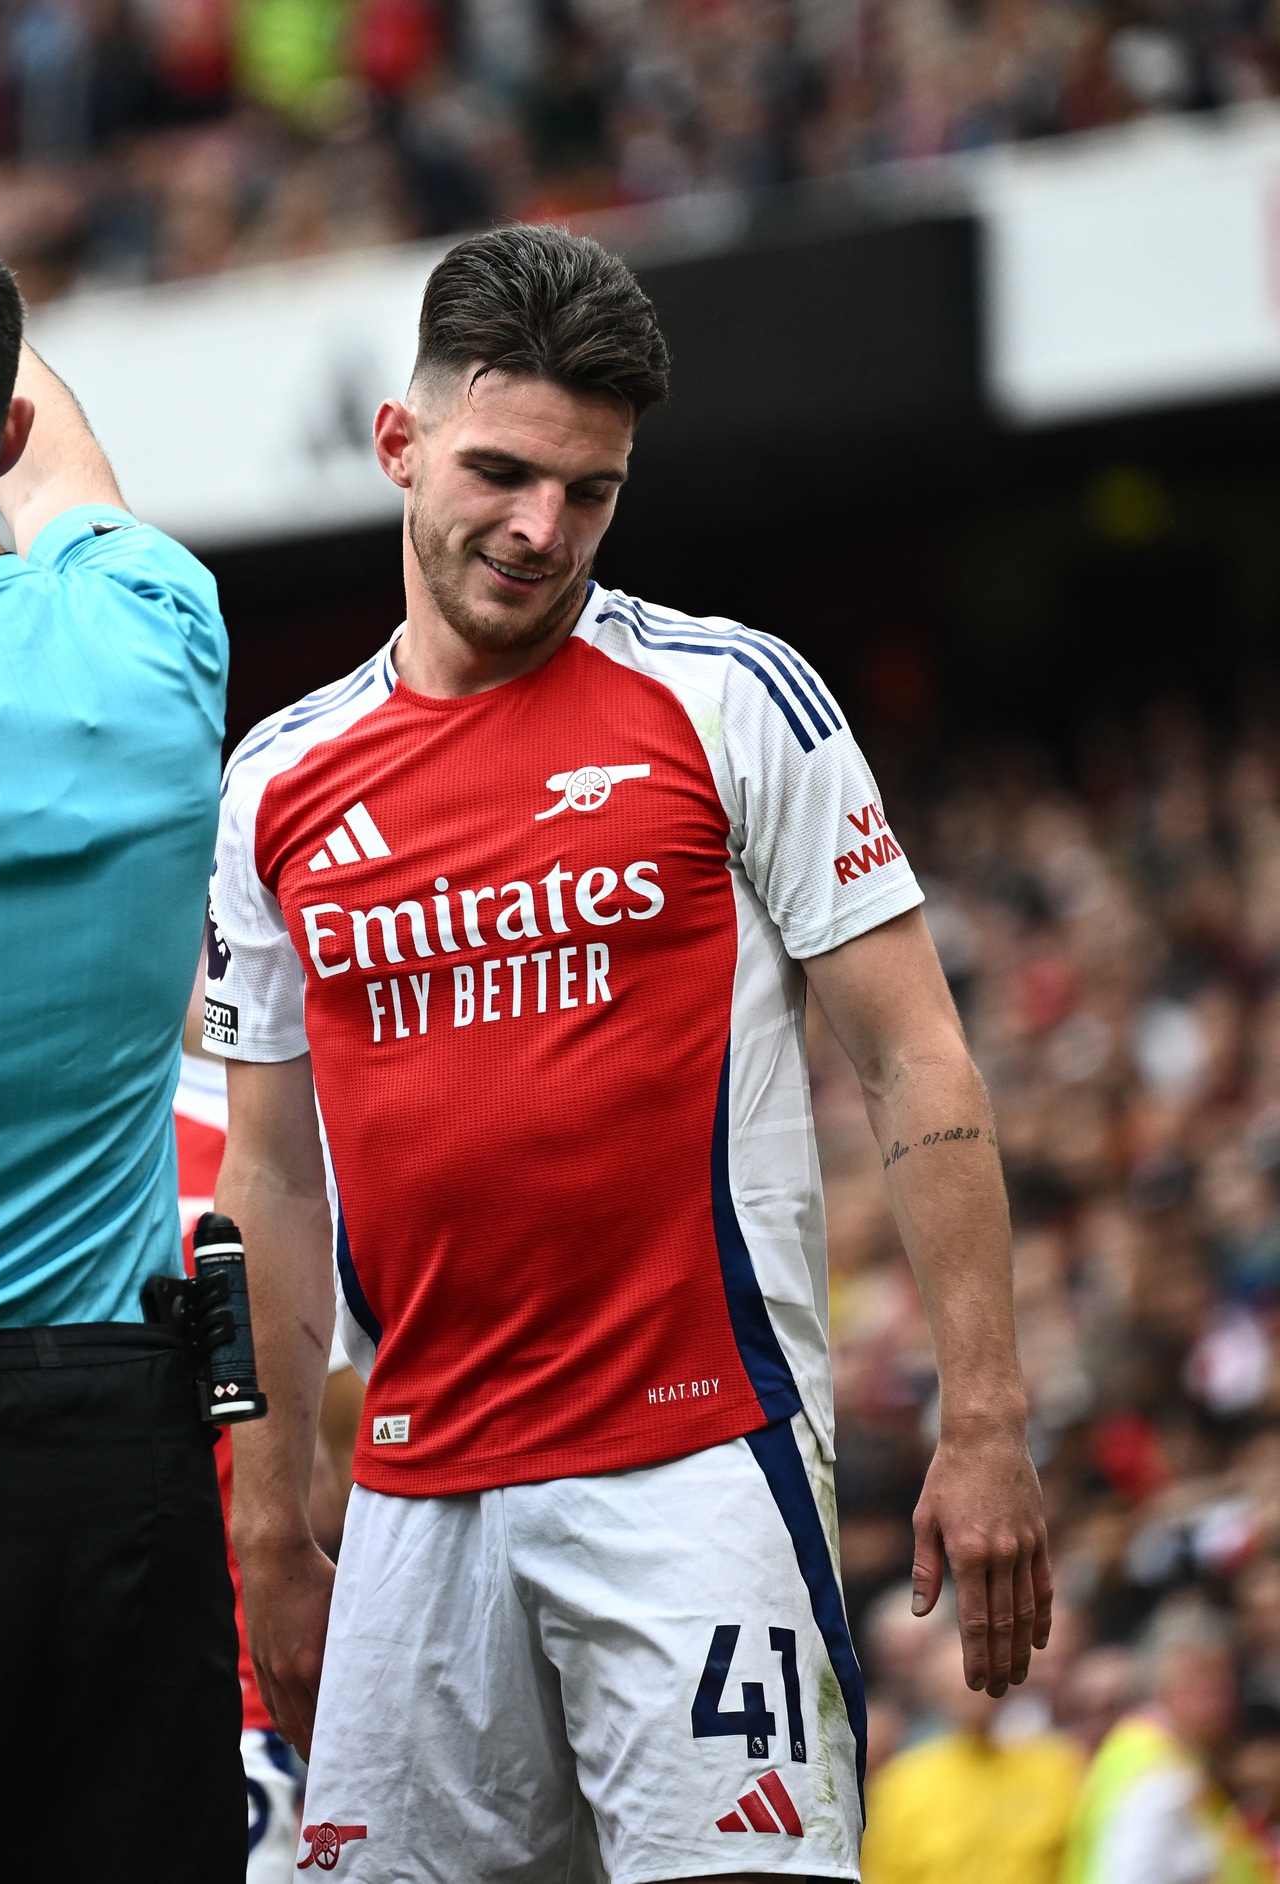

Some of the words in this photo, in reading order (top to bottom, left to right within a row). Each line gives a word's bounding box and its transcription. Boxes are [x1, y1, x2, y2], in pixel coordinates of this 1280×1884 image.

[834, 834, 902, 885] RWA
[300, 860, 665, 979] Emirates
[366, 972, 431, 1043] FLY
[453, 942, 613, 1028] BETTER
[923, 1127, 980, 1146] 07.08.22
[648, 1378, 719, 1404] HEAT.RDY
[690, 1624, 807, 1764] 41
